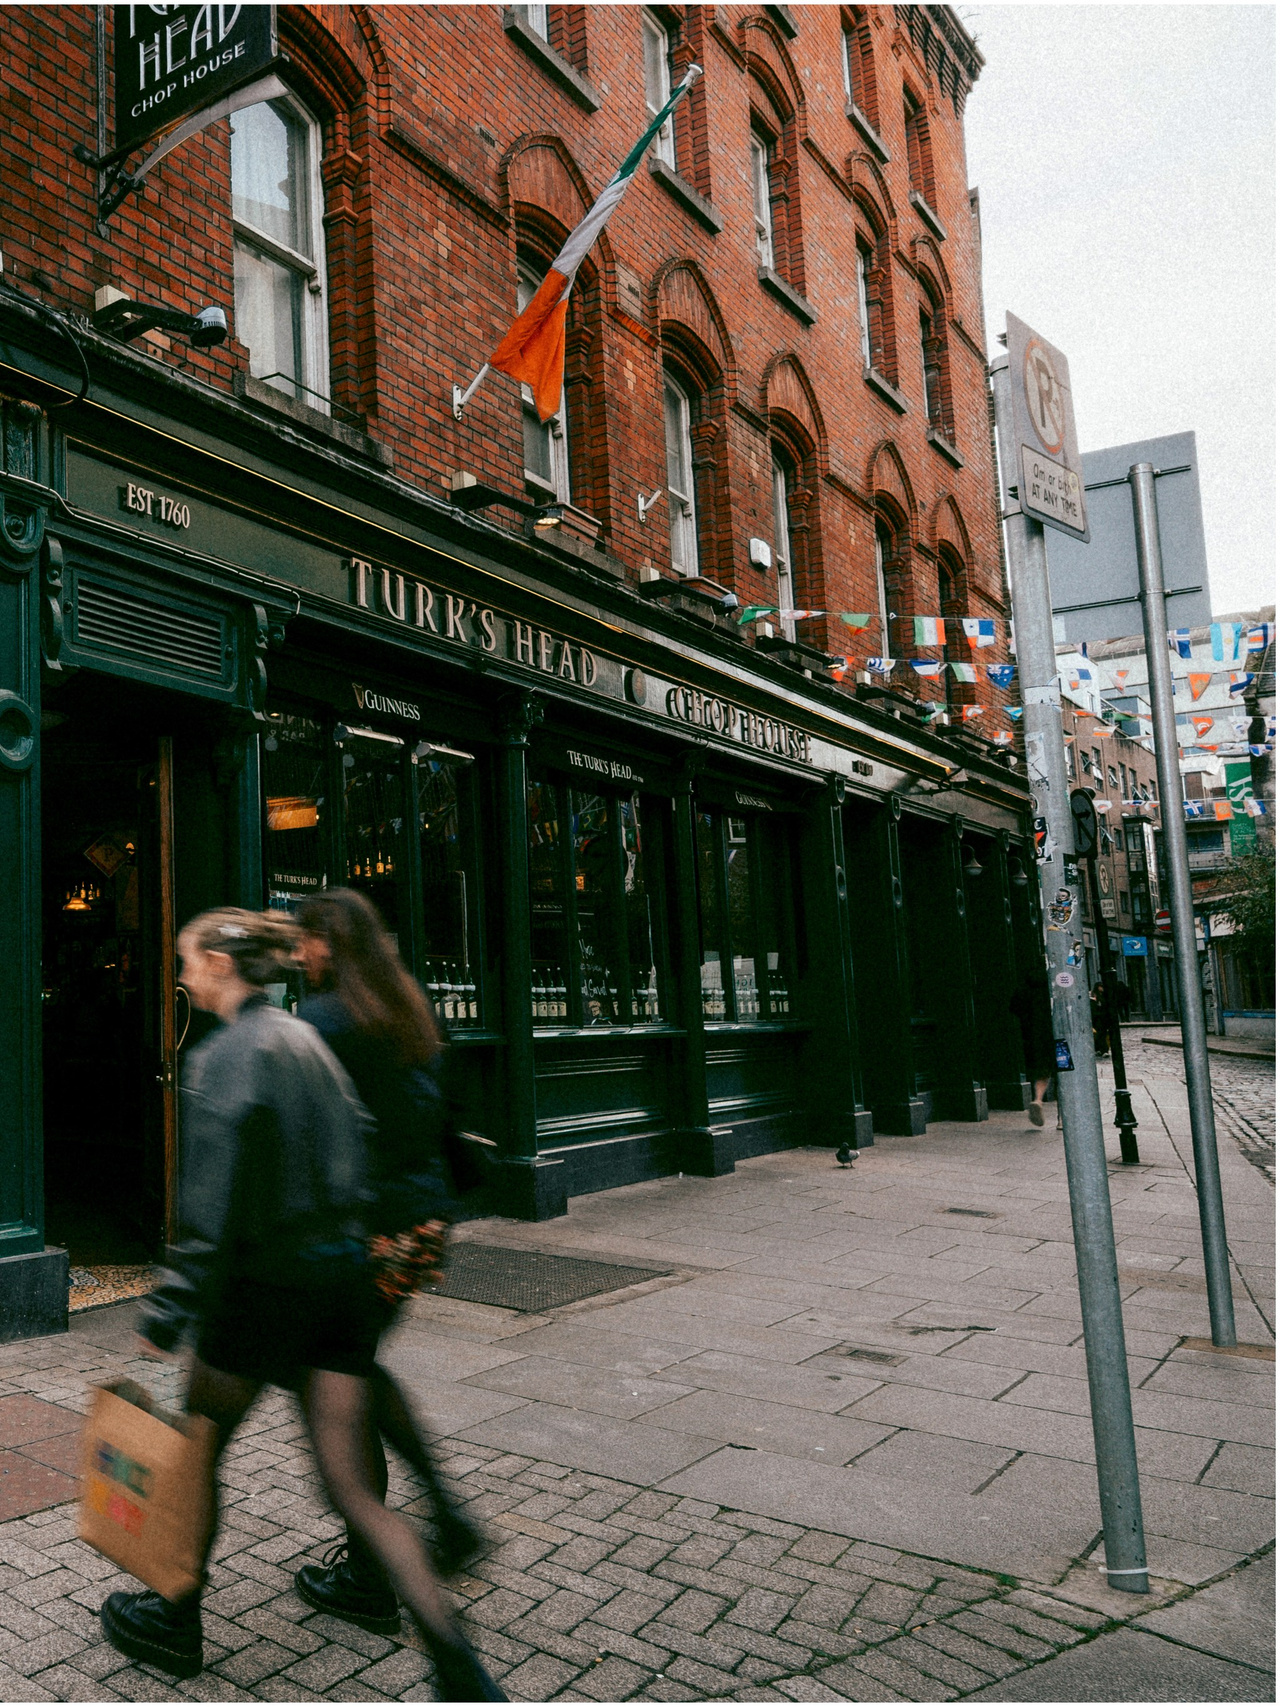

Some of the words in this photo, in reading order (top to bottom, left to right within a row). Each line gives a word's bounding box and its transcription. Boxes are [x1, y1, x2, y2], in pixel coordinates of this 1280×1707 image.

[131, 83, 177, 117] CHOP
[183, 40, 246, 88] HOUSE
[138, 5, 242, 91] HEAD
[126, 482, 155, 516] EST
[159, 496, 191, 529] 1760
[1032, 482, 1041, 499] AT
[1044, 488, 1058, 508] ANY
[350, 556, 497, 653] TURK'S
[515, 619, 598, 687] HEAD
[364, 689, 421, 721] GUINNESS
[674, 685, 739, 739] CHOP
[747, 714, 814, 763] HOUSE
[567, 749, 583, 768] THE
[584, 755, 609, 775] TURK'S
[610, 760, 632, 779] HEAD
